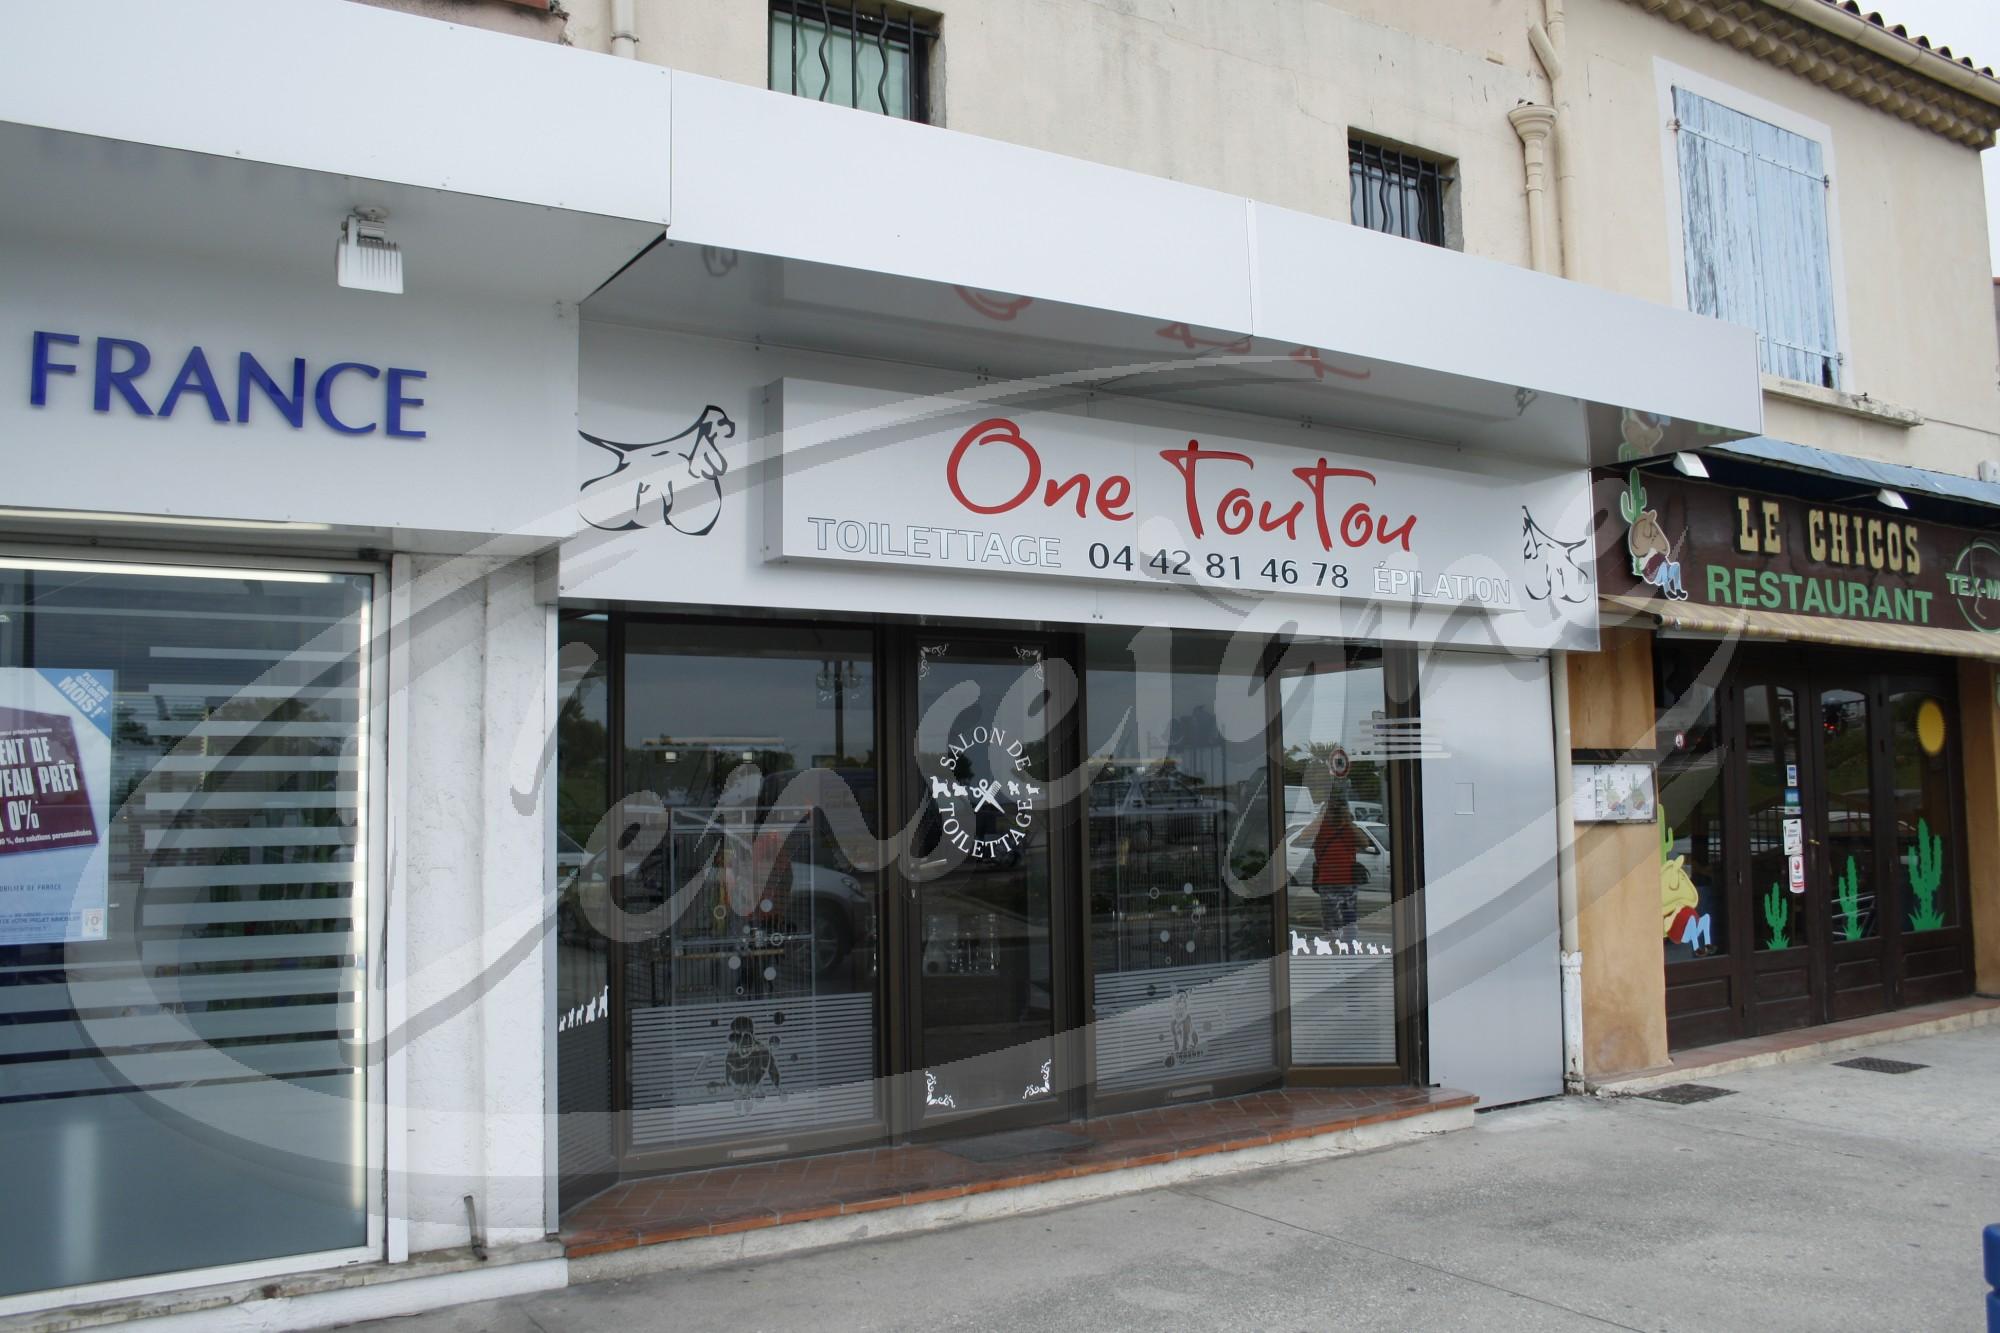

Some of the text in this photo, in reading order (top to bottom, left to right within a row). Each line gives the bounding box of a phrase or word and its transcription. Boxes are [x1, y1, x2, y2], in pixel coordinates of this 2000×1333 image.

[29, 330, 428, 439] FRANCE
[946, 417, 1418, 553] One TouTou
[807, 517, 1062, 568] TOILETTAGE
[1736, 496, 1921, 575] LE CHICOS
[1088, 542, 1350, 589] 04 42 81 46 78
[1372, 560, 1511, 605] ÉPILATION
[1706, 564, 1933, 624] RESTAURANT
[30, 737, 52, 763] DE
[940, 726, 1032, 771] SALON DE
[37, 760, 79, 793] PRÊT
[938, 798, 1033, 858] TOILETTAGE
